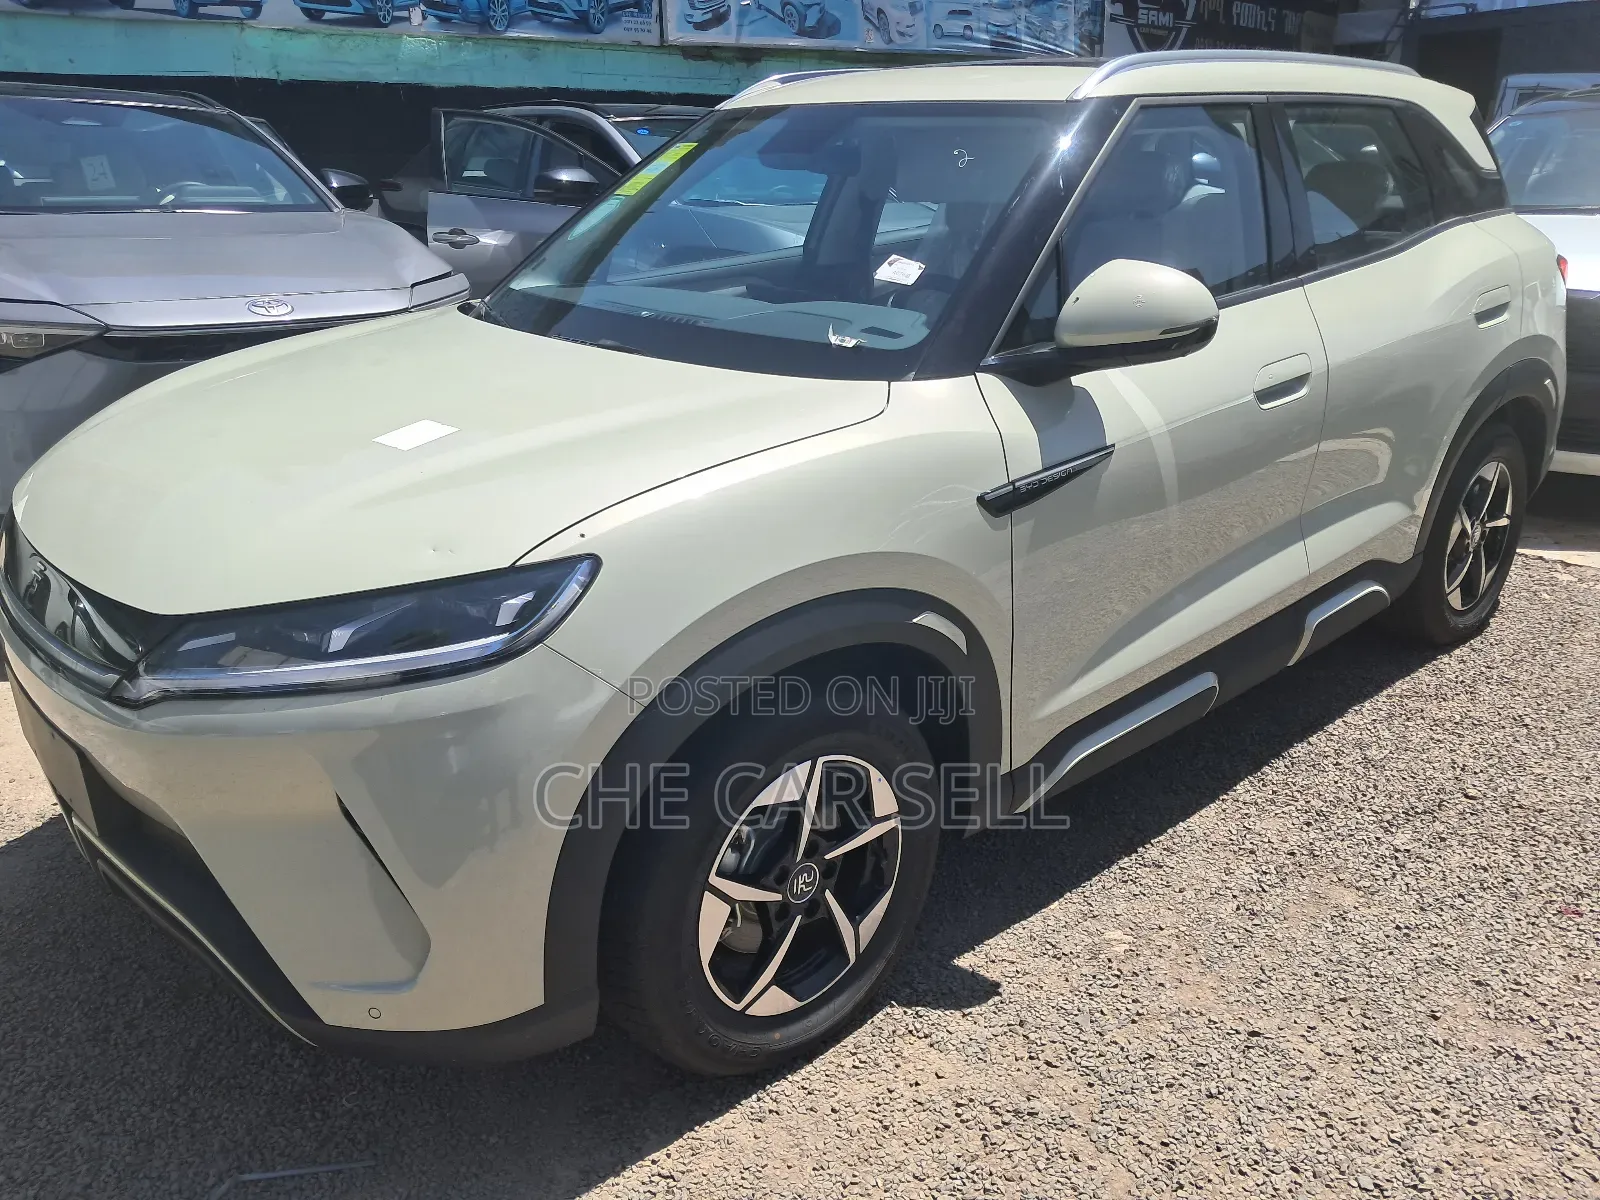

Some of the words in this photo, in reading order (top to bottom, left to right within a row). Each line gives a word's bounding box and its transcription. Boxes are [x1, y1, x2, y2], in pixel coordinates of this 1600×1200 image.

[1138, 9, 1173, 27] SAMI
[1019, 481, 1039, 493] BYD
[1041, 467, 1074, 485] DESIGN
